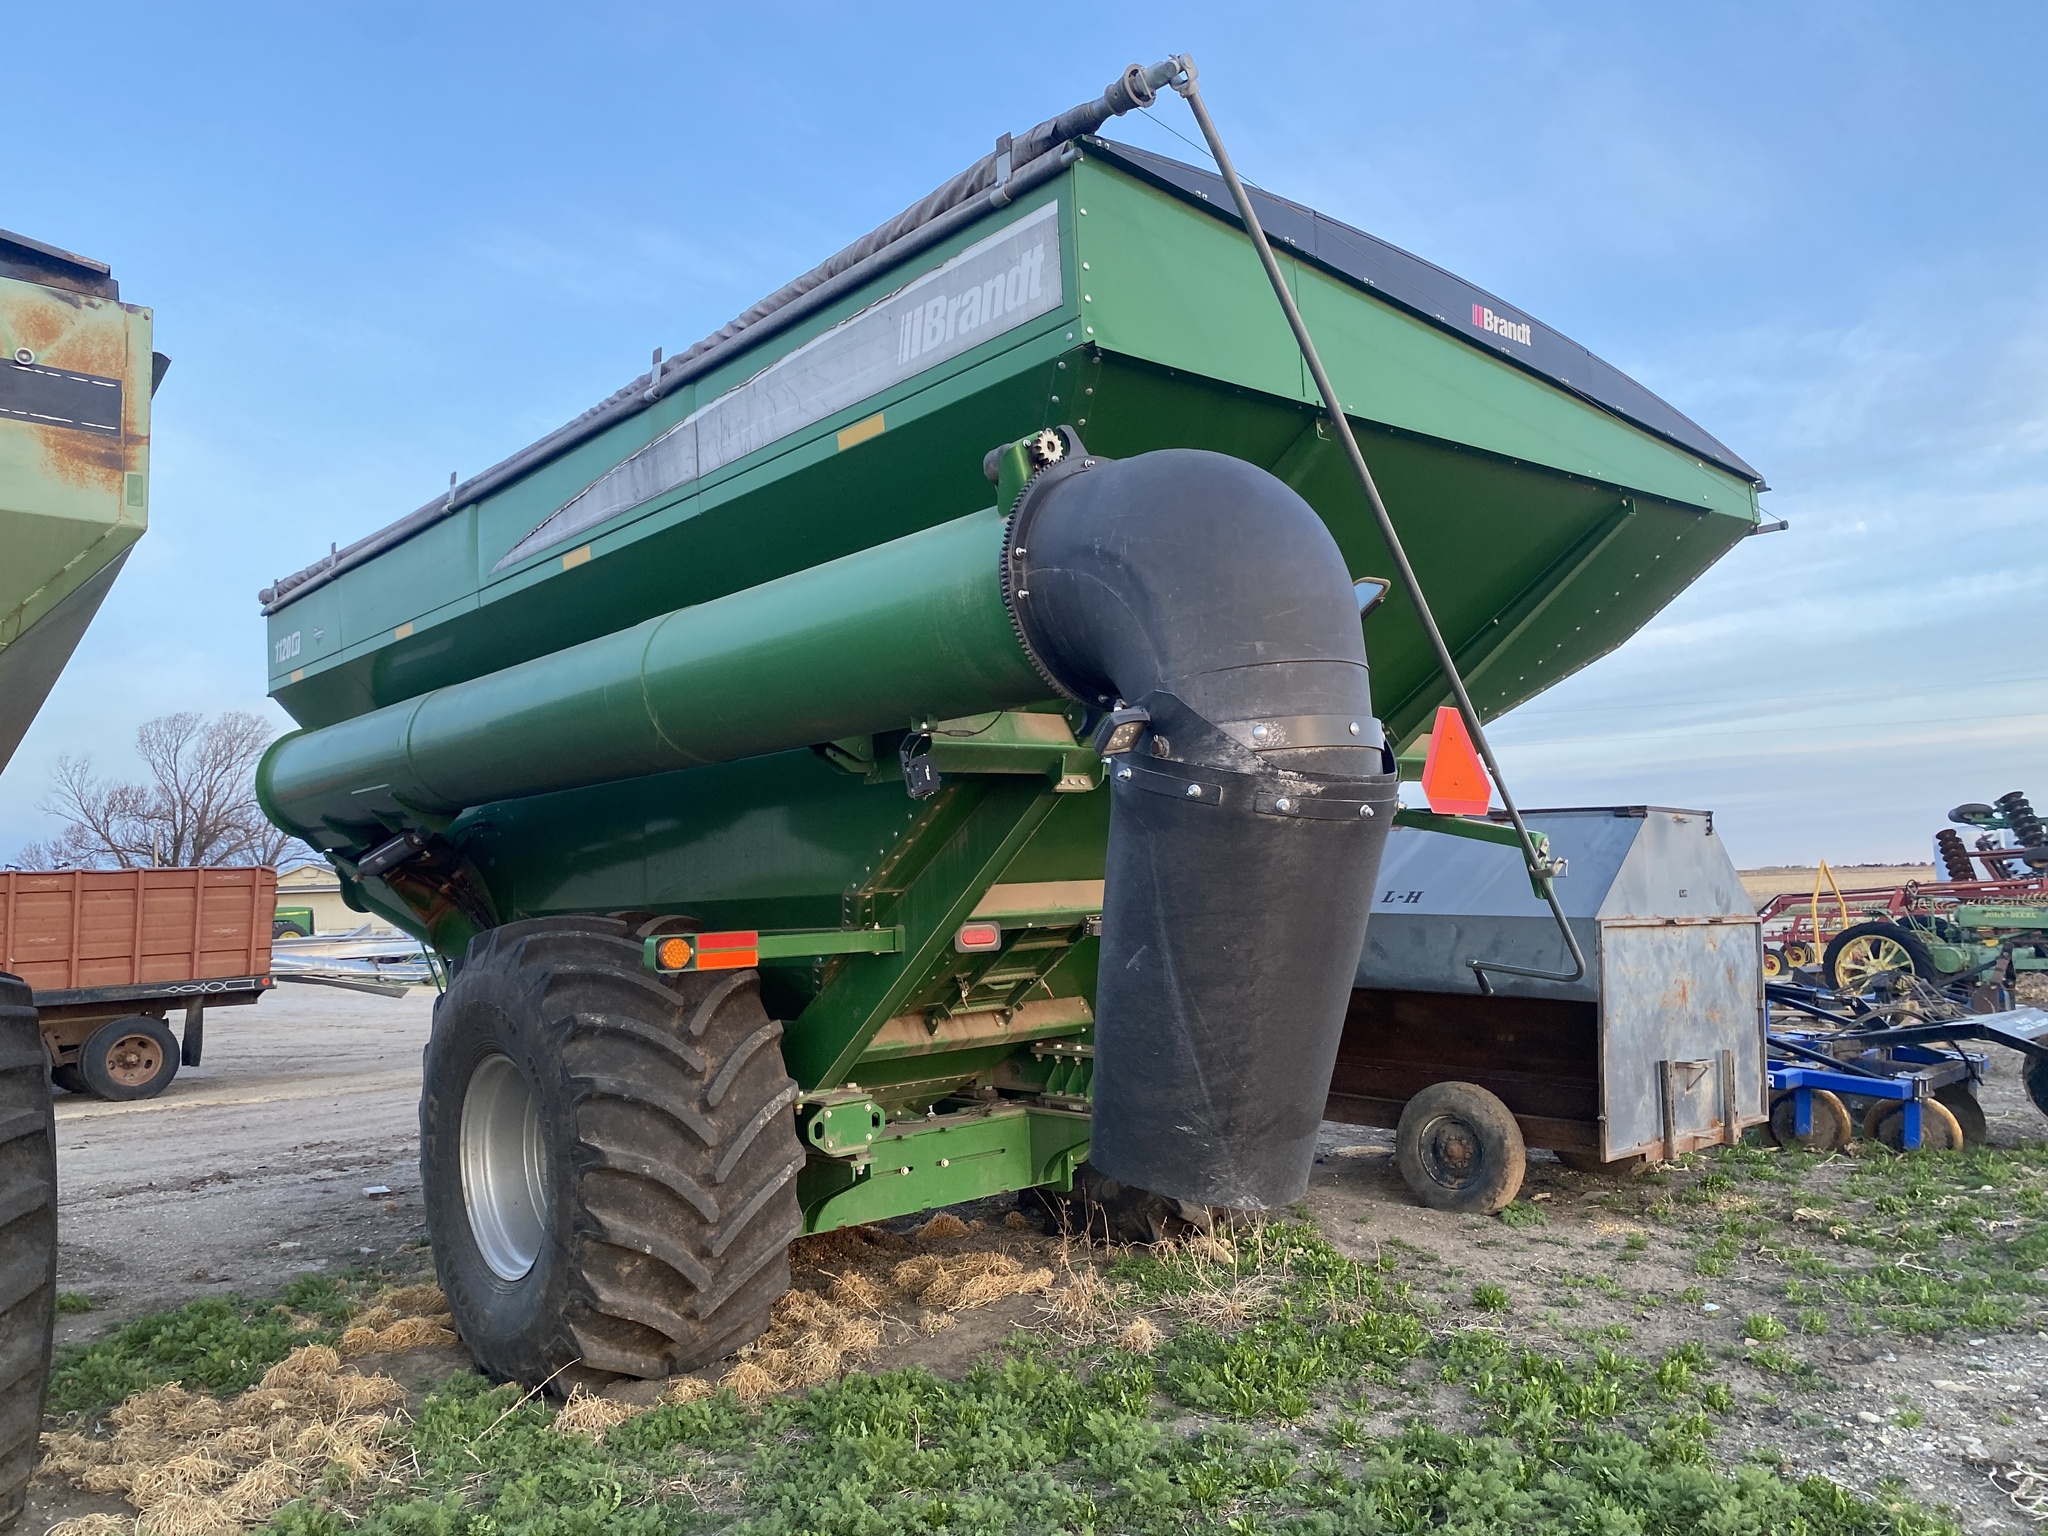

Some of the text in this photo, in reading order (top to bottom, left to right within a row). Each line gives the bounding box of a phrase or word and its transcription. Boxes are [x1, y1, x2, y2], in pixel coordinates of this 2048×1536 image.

[923, 243, 1045, 351] Brandt
[1484, 307, 1531, 346] Brandt
[1381, 890, 1424, 903] L-H
